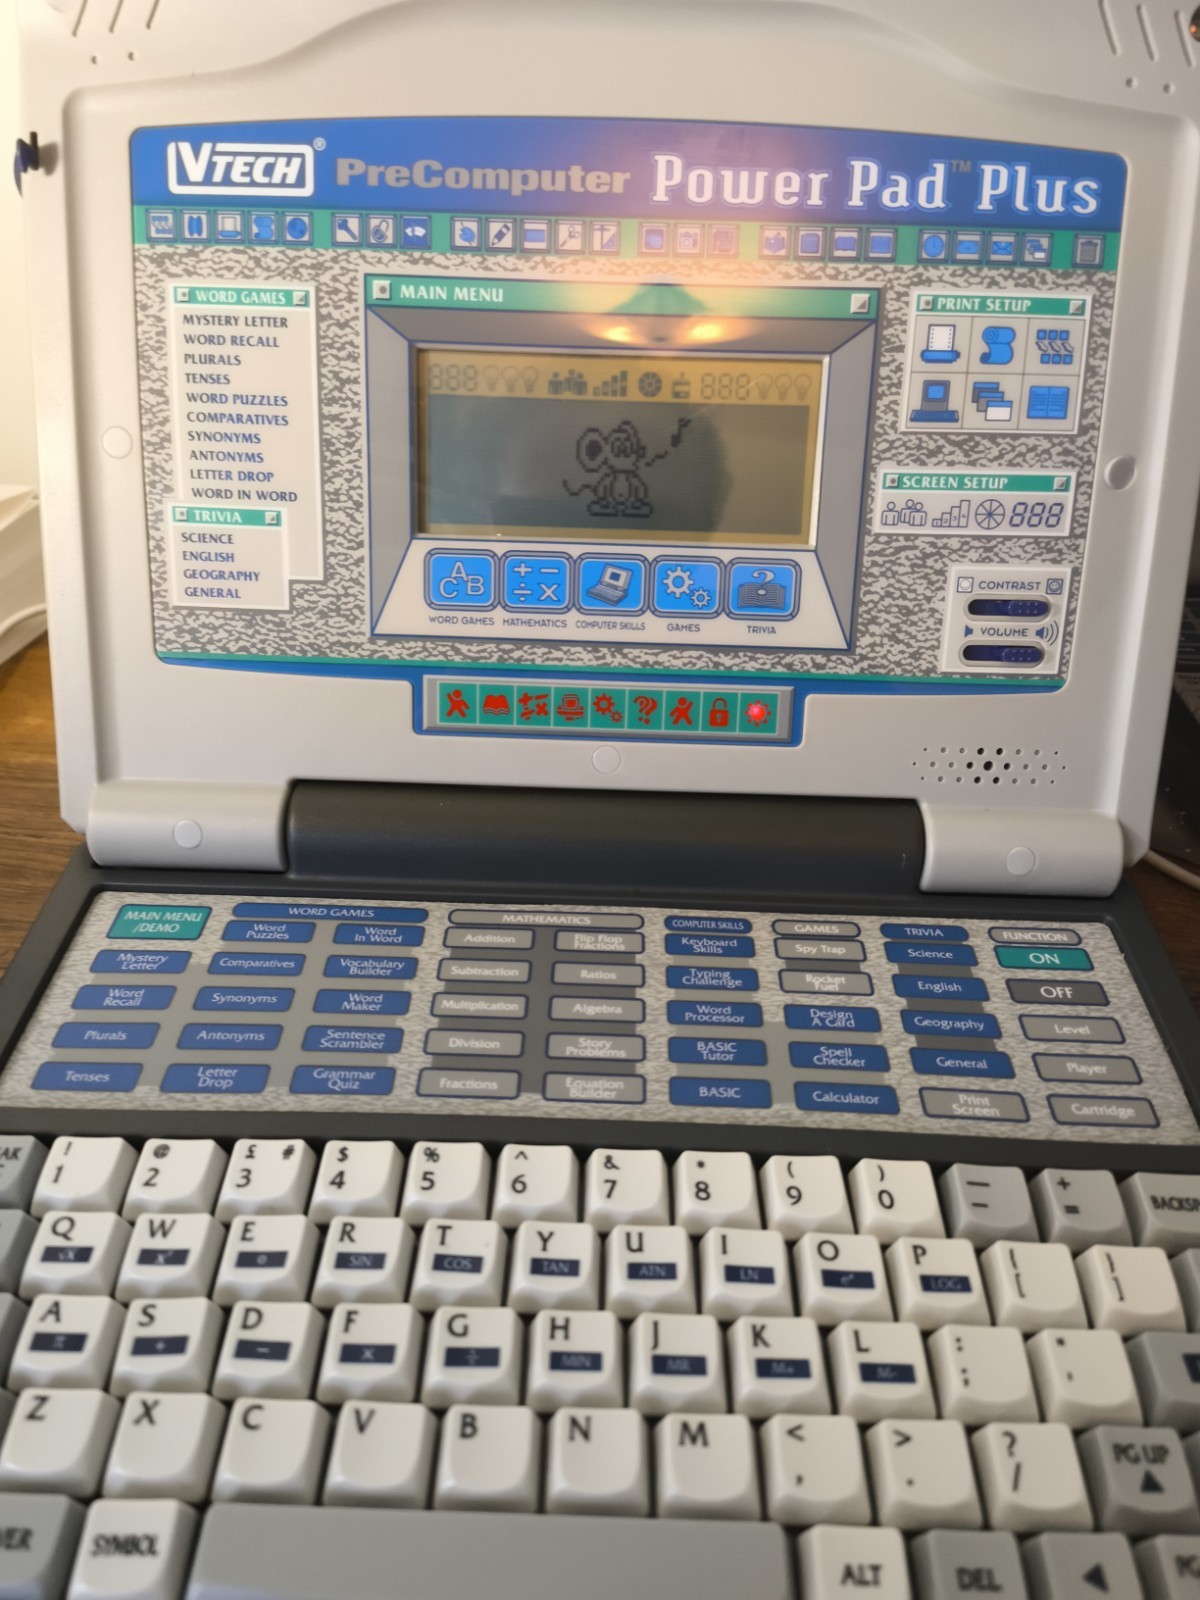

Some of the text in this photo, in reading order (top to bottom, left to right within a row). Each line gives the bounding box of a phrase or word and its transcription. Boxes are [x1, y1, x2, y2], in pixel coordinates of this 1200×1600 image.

[176, 141, 303, 184] VTECH
[336, 153, 1099, 214] PreComputer Power Pad Plus
[196, 290, 286, 304] WORD GAMES
[400, 284, 504, 302] MAIN MENU
[937, 298, 1032, 312] PRINT SETUP
[183, 315, 288, 328] MYSTERY LETTER
[184, 334, 280, 347] WORD RECALL
[184, 354, 241, 365] PLURALS
[185, 373, 230, 384] TENSES
[186, 393, 288, 406] WORD PUZZLES
[187, 412, 289, 426] COMPARATIVES
[188, 431, 261, 443] SYNONYMS
[189, 451, 264, 463] ANTONYMS
[190, 469, 274, 482] LETTER DROP
[903, 476, 1008, 489] SCREEN SETUP
[192, 488, 297, 502] WORD IN WORD
[193, 510, 242, 523] TRIVIA
[1009, 502, 1064, 527] 888
[181, 532, 234, 544] SCIENCE
[182, 551, 235, 562] ENGLISH
[183, 569, 260, 582] GEOGRAPHY
[979, 581, 1041, 591] CONTRAST
[184, 587, 241, 598] GENERAL
[429, 616, 495, 626] WORD GAMES
[502, 618, 567, 628] MATHEMATICS
[576, 620, 646, 631] COMPUTER SKILLS
[667, 623, 700, 632] GAMES
[747, 626, 776, 634] TRIVIA
[981, 628, 1028, 637] VOLUME
[124, 911, 203, 922] MAIN MENU
[288, 908, 375, 918] WORD GAMES
[502, 914, 591, 925] MATHEMATICS
[672, 920, 744, 930] COMPUTER SKILLS
[132, 923, 180, 933] /DEMO
[364, 927, 397, 935] Word
[794, 924, 839, 934] GAMES
[904, 927, 944, 937] TRIVIA
[245, 931, 289, 940] Puzzles
[355, 934, 402, 943] In Word
[464, 934, 515, 944] Addition
[574, 934, 622, 944] Flip Flop
[1003, 932, 1067, 941] FUNCTION
[574, 942, 626, 951] Fractions
[682, 937, 737, 948] Keyboard
[693, 945, 723, 954] Skills
[796, 945, 846, 955] Spy Trap
[908, 949, 953, 959] Science
[117, 953, 168, 964] Mystery
[219, 958, 295, 970] Comparatives
[340, 958, 405, 970] Vocabulary
[1029, 953, 1060, 964] ON
[121, 962, 159, 970] Letter
[349, 967, 392, 976] Builder
[451, 965, 519, 977] Subtraction
[581, 970, 617, 980] Ratios
[689, 969, 730, 980] Typing
[805, 975, 846, 985] Rocket
[682, 977, 742, 988] Challenge
[815, 983, 839, 991] Fuel
[917, 982, 962, 992] English
[109, 989, 144, 998] Word
[349, 993, 383, 1003] Word
[1040, 987, 1073, 998] OFF
[103, 997, 142, 1006] Recall
[213, 993, 277, 1004] Synonyms
[341, 1002, 382, 1011] Maker
[441, 1000, 519, 1012] Multiplication
[573, 1004, 622, 1016] Algebra
[696, 1005, 731, 1015] Word
[685, 1013, 745, 1023] Processor
[810, 1009, 853, 1020] Design
[825, 1018, 855, 1027] Card
[915, 1016, 984, 1031] Geography
[326, 1030, 386, 1040] Sentence
[1055, 1024, 1091, 1035] Level
[84, 1031, 127, 1040] Plurals
[196, 1029, 265, 1042] Antonyms
[320, 1038, 384, 1049] Scrambler
[449, 1038, 500, 1049] Division
[578, 1038, 612, 1050] Story
[697, 1041, 737, 1052] BASIC
[566, 1047, 626, 1058] Problems
[702, 1052, 734, 1061] Tutor
[820, 1046, 852, 1057] Spell
[813, 1056, 865, 1067] Checker
[936, 1057, 988, 1069] General
[197, 1066, 238, 1077] Letter
[313, 1068, 376, 1079] Grammar
[1066, 1062, 1108, 1075] Player
[65, 1071, 110, 1082] Tenses
[197, 1077, 234, 1090] Drop
[328, 1078, 361, 1091] Quiz
[440, 1078, 498, 1090] Fractions
[566, 1078, 624, 1091] Equation
[570, 1087, 617, 1099] Builder
[700, 1087, 741, 1098] BASIC
[812, 1091, 879, 1104] Calculator
[959, 1094, 990, 1106] Print
[953, 1105, 999, 1117] Screen
[1071, 1104, 1135, 1119] Cartridge
[142, 1168, 160, 1188] 2
[330, 1170, 346, 1190] 4
[511, 1174, 528, 1194] 6
[694, 1181, 711, 1201] 8
[51, 1216, 76, 1241] Q
[148, 1218, 176, 1238] W
[349, 1256, 372, 1266] SIN
[443, 1258, 472, 1270] COS
[542, 1261, 570, 1273] TAN
[40, 1301, 62, 1322] A
[240, 1308, 263, 1330] D
[448, 1314, 468, 1338] G
[751, 1324, 771, 1347] K
[25, 1396, 50, 1421] Z
[133, 1400, 160, 1426] X
[242, 1404, 264, 1430] C
[354, 1408, 376, 1434] V
[460, 1414, 478, 1439] B
[568, 1416, 592, 1442] N
[678, 1421, 709, 1447] M
[1112, 1443, 1169, 1465] PG UP
[841, 1564, 882, 1586] ALT
[957, 1567, 1002, 1592] DEL
